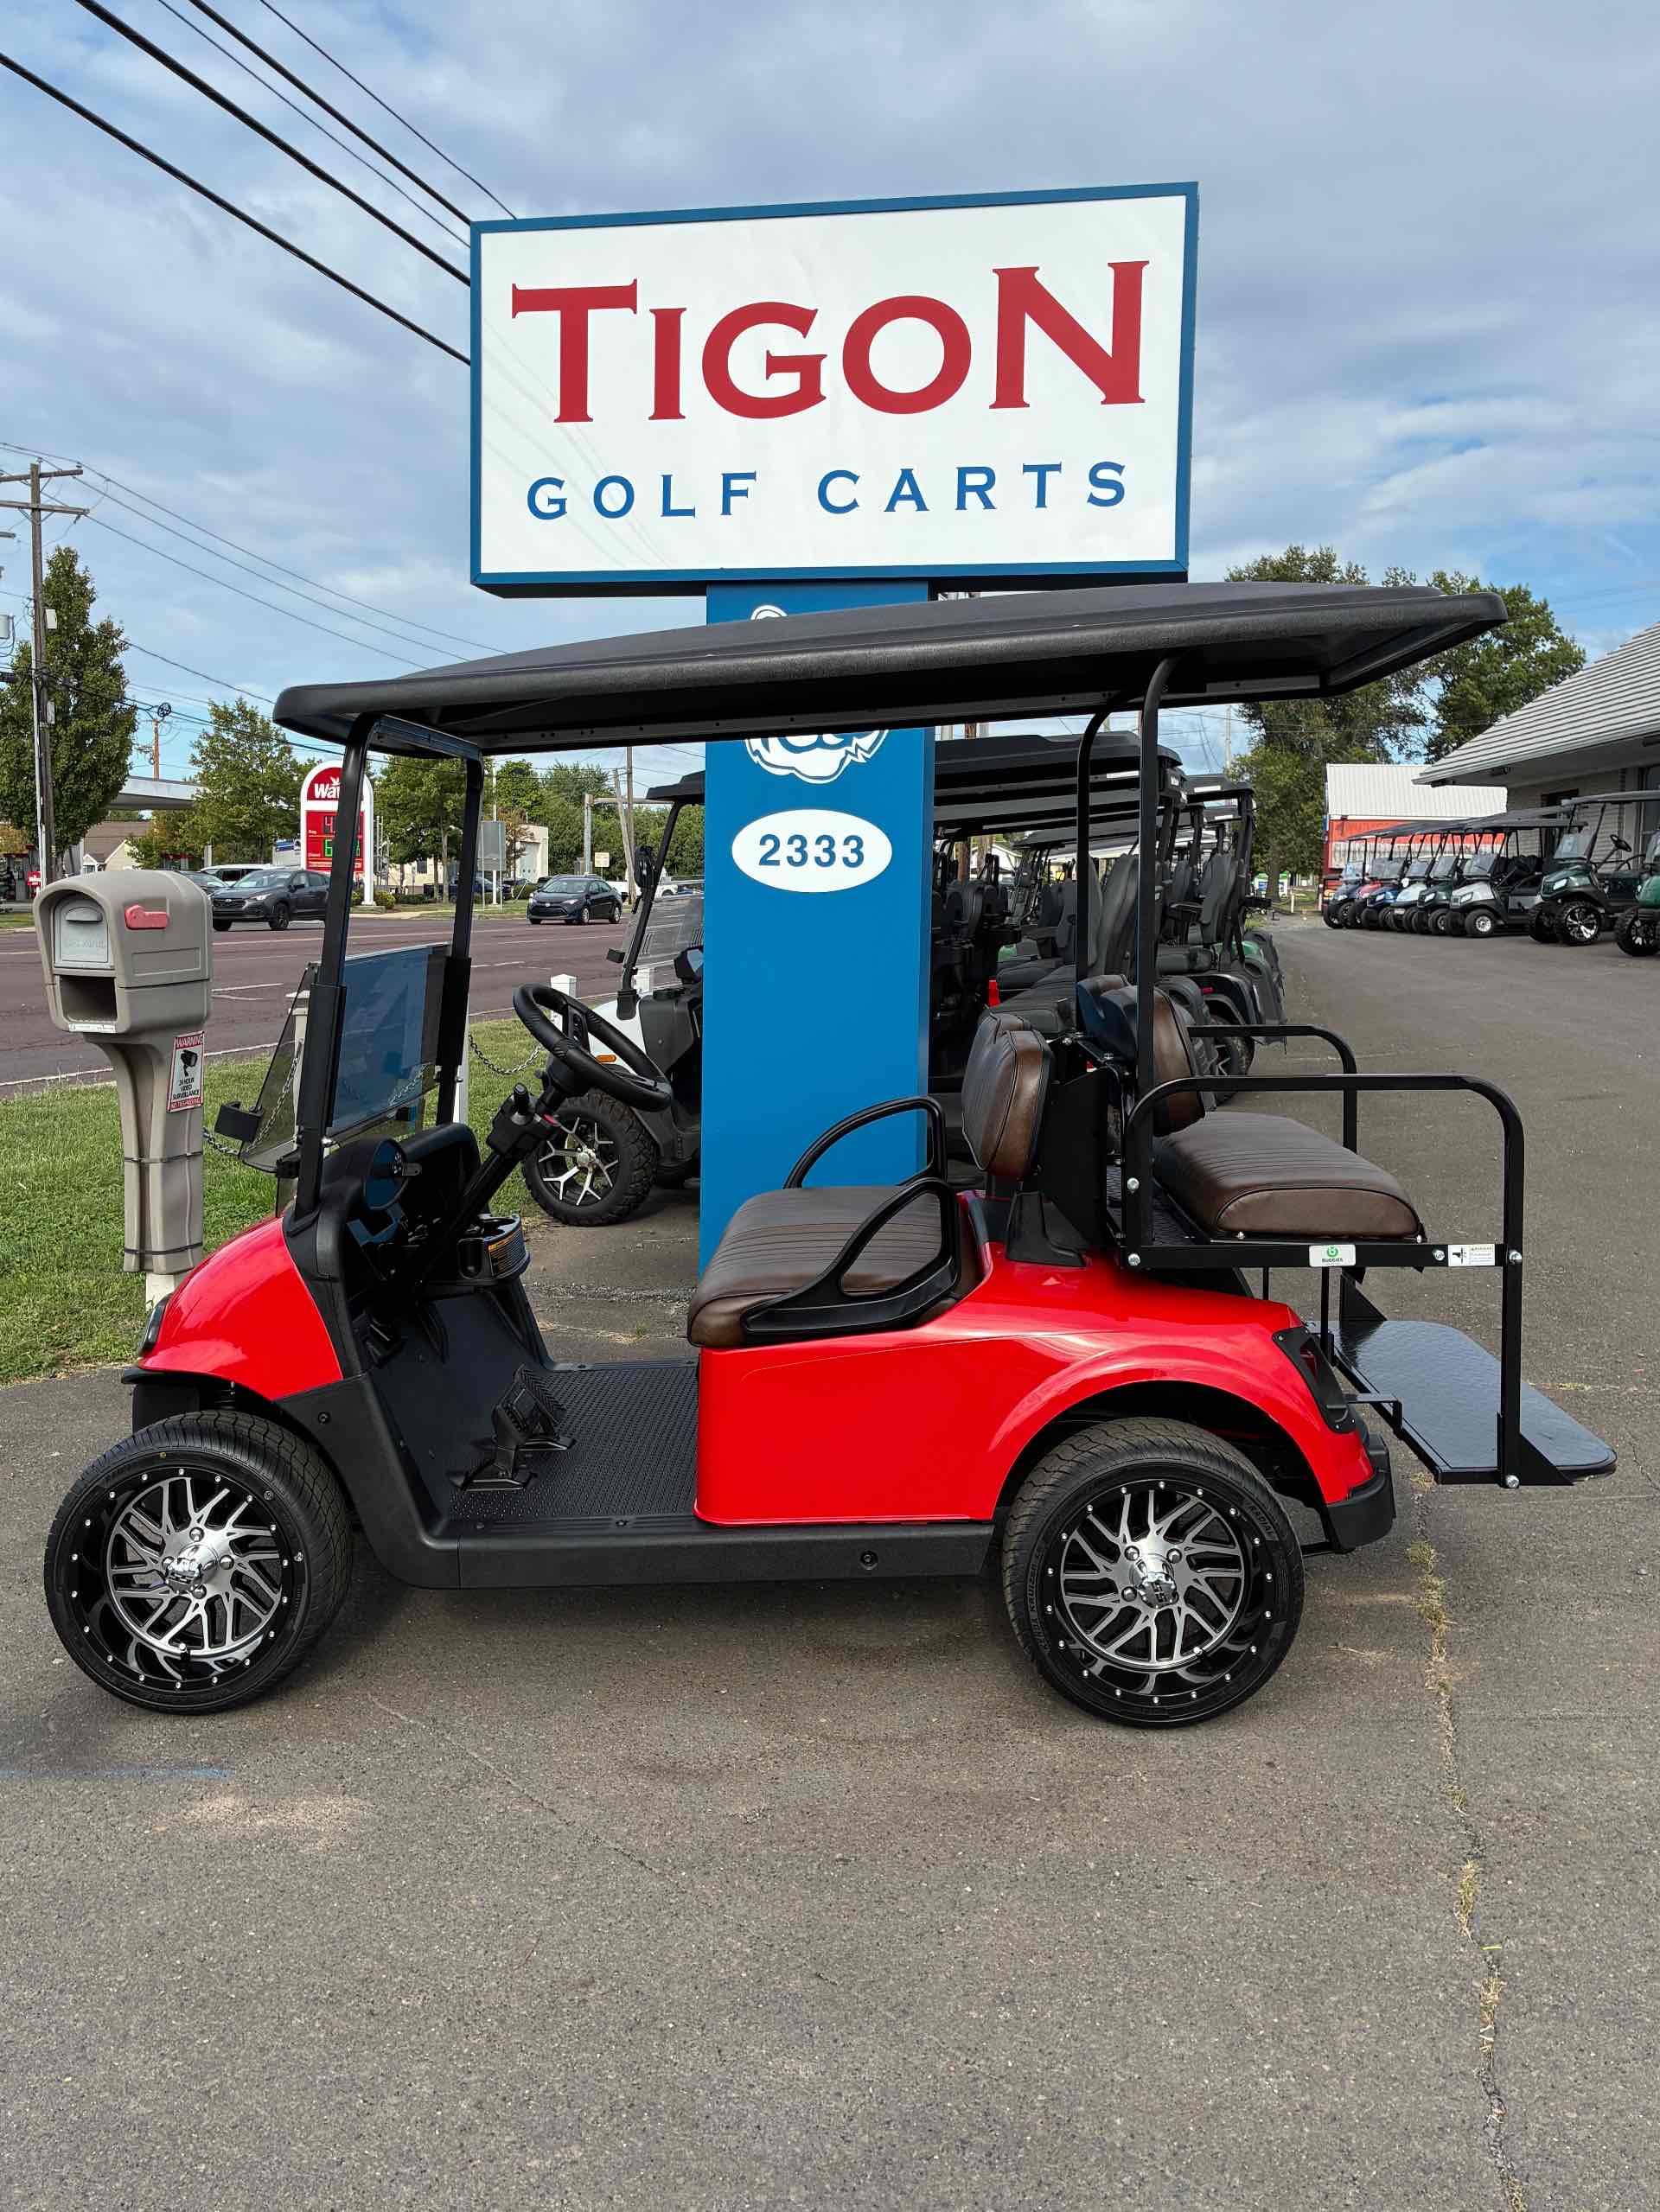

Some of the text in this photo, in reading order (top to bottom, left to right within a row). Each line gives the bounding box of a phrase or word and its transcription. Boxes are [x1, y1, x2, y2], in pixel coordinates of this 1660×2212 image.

[511, 260, 1150, 424] TIGON
[527, 461, 1127, 520] GOLF CARTS
[758, 833, 865, 868] 2333
[176, 1034, 203, 1049] WARNING
